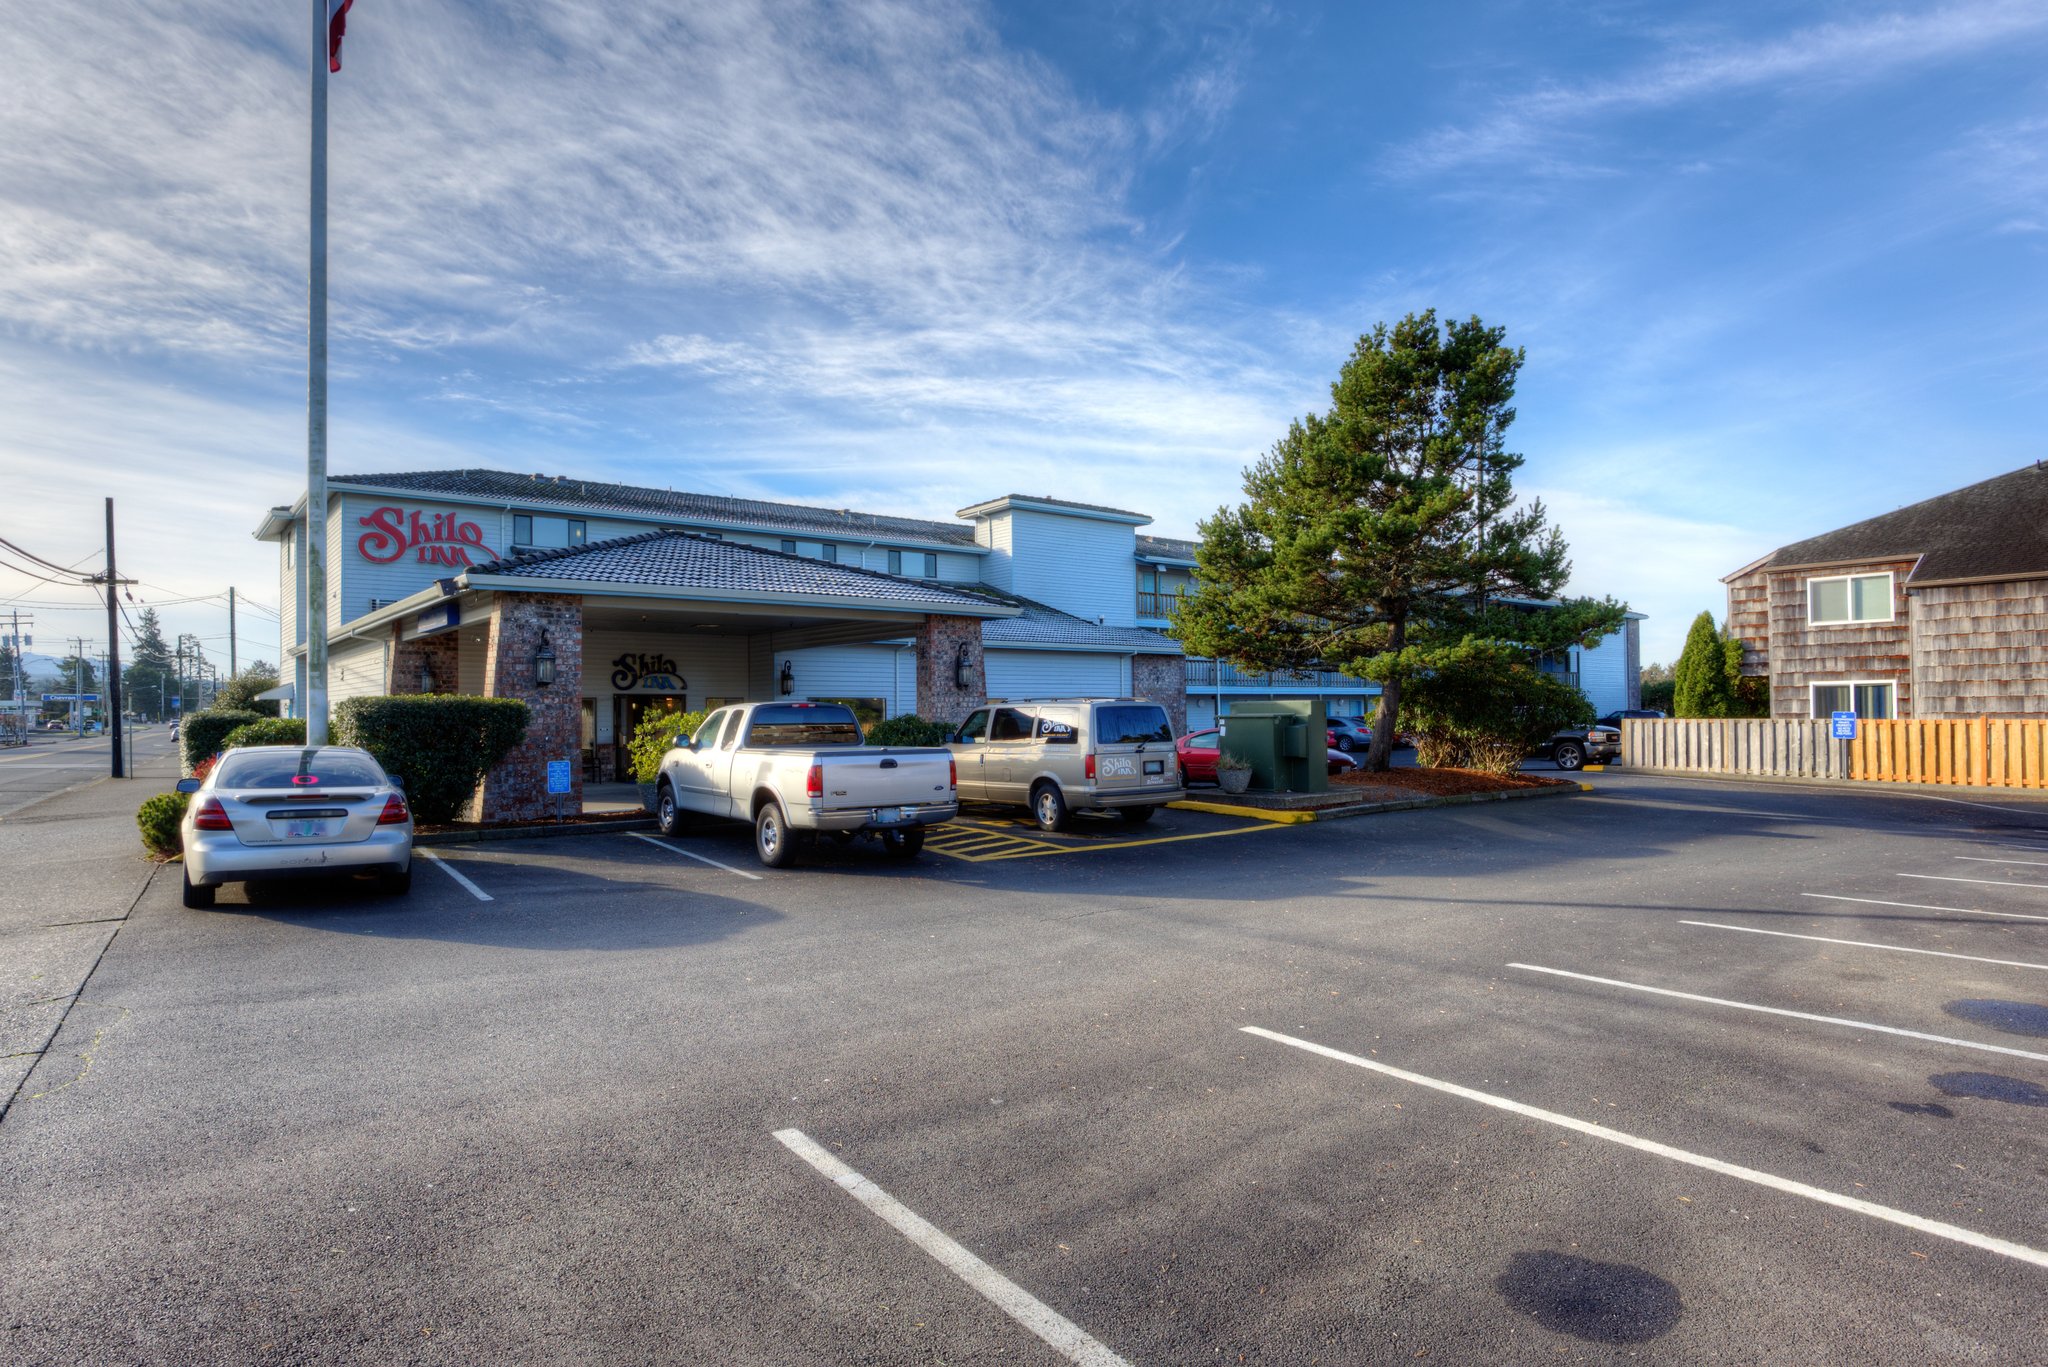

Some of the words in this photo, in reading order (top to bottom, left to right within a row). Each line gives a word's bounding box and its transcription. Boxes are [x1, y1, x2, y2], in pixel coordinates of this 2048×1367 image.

[358, 506, 500, 564] Shilo
[611, 653, 688, 691] Shilo
[1102, 757, 1137, 777] Shilo
